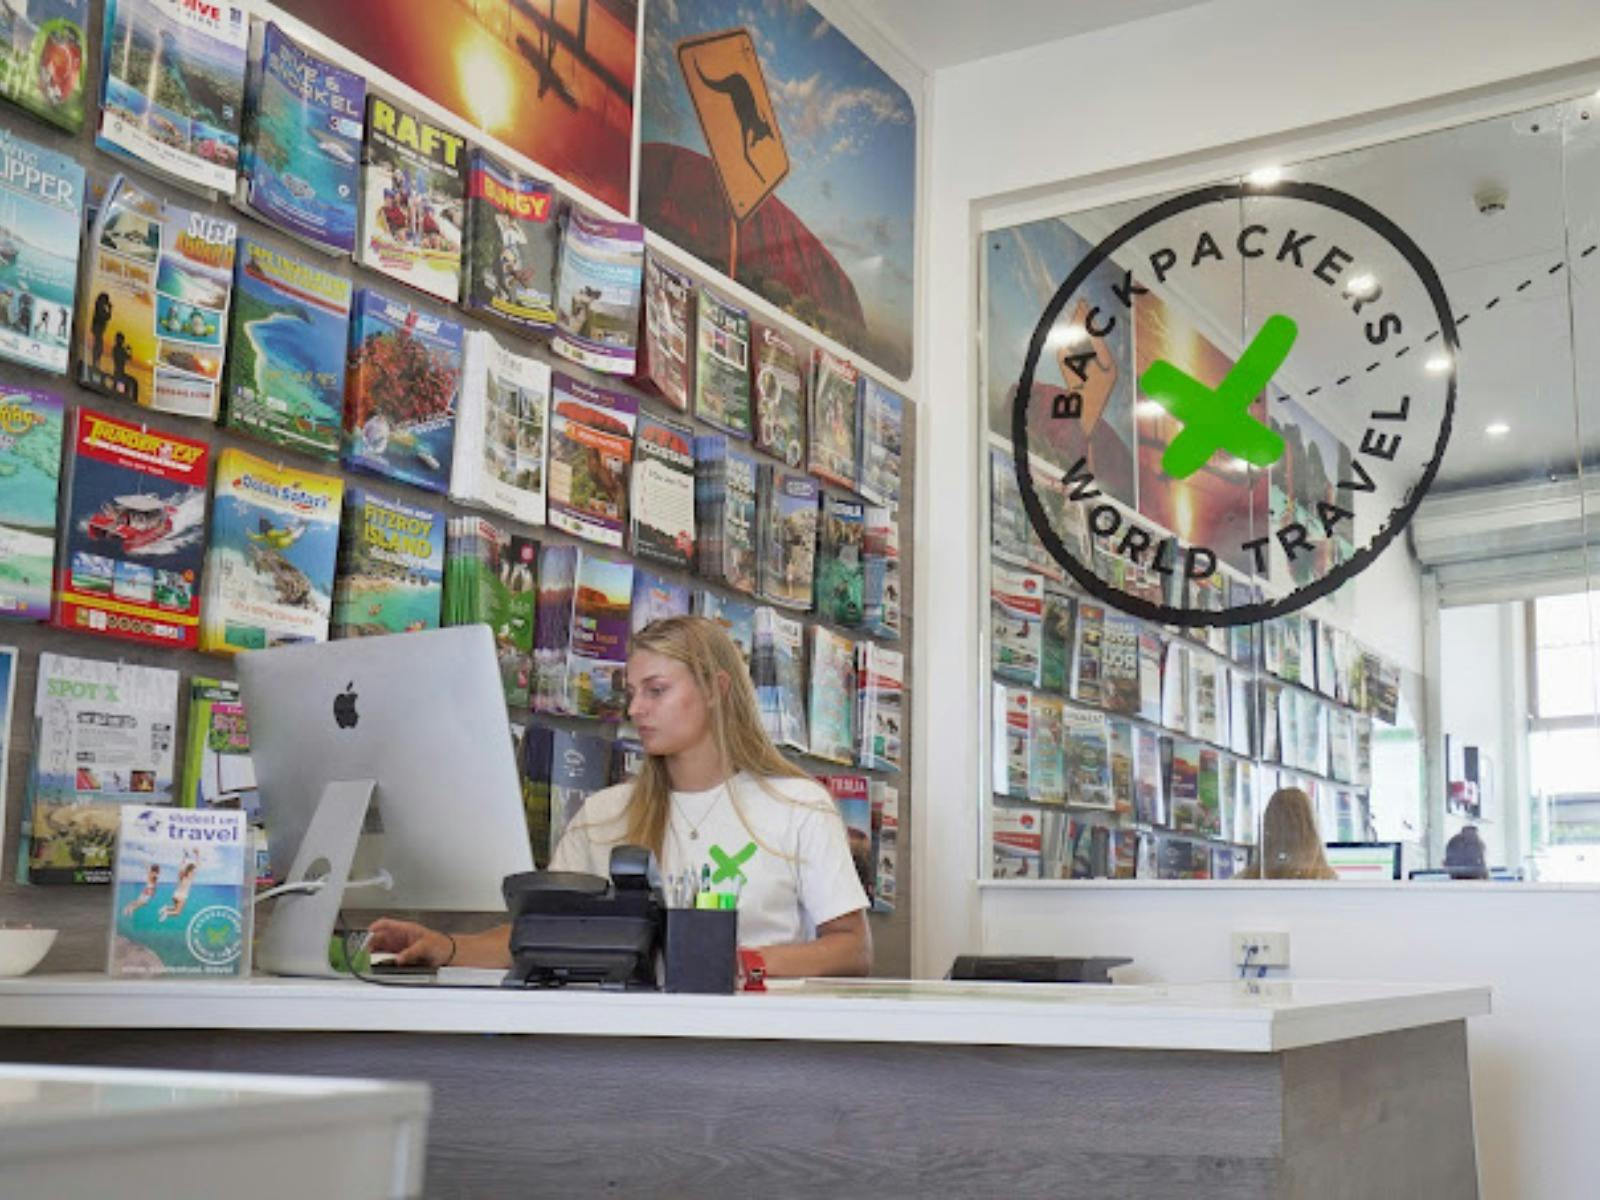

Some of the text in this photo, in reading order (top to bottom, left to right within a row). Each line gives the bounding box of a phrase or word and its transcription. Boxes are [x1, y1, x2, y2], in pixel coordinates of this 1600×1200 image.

[373, 100, 464, 167] RAFT
[0, 154, 78, 208] IPPER
[484, 176, 545, 218] BUNGY
[1051, 224, 1402, 420] BACKPACKERS
[1061, 395, 1410, 579] WORLD TRAVEL
[364, 503, 433, 539] FITZROY
[364, 521, 433, 559] ISLAND
[47, 677, 120, 703] SPOT X
[168, 824, 238, 842] travel
